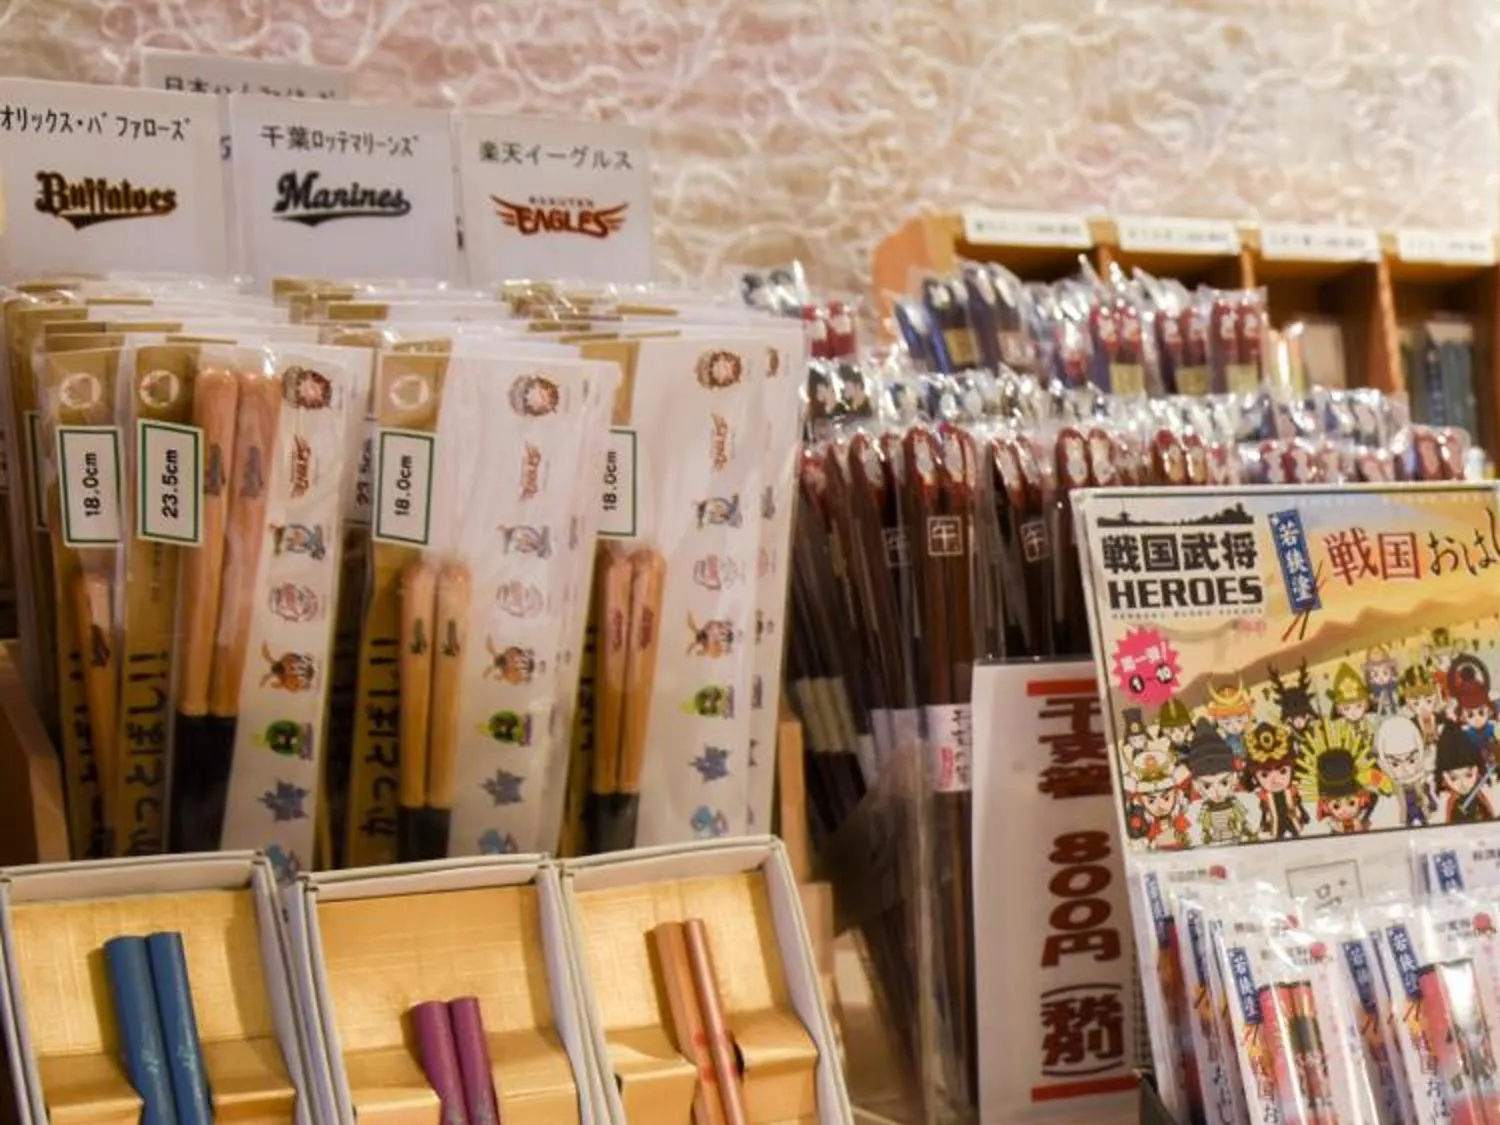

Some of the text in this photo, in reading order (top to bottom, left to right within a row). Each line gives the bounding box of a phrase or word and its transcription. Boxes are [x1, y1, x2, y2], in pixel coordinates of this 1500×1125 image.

[260, 123, 420, 160] 千葉ロッテマリーンズ
[478, 139, 634, 171] 楽天イーグルス
[33, 170, 179, 222] Buffaloes
[272, 168, 412, 220] Marines
[508, 205, 614, 240] EAGLES
[80, 450, 100, 519] 18.0cm
[160, 447, 179, 520] 23.5cm
[392, 453, 414, 518] 18.0cm
[601, 449, 619, 513] 18.0cm
[1101, 530, 1259, 575] 戦国武将
[1106, 576, 1265, 611] HEROES
[1040, 829, 1121, 968] 800円
[1040, 981, 1126, 1078] (税別)
